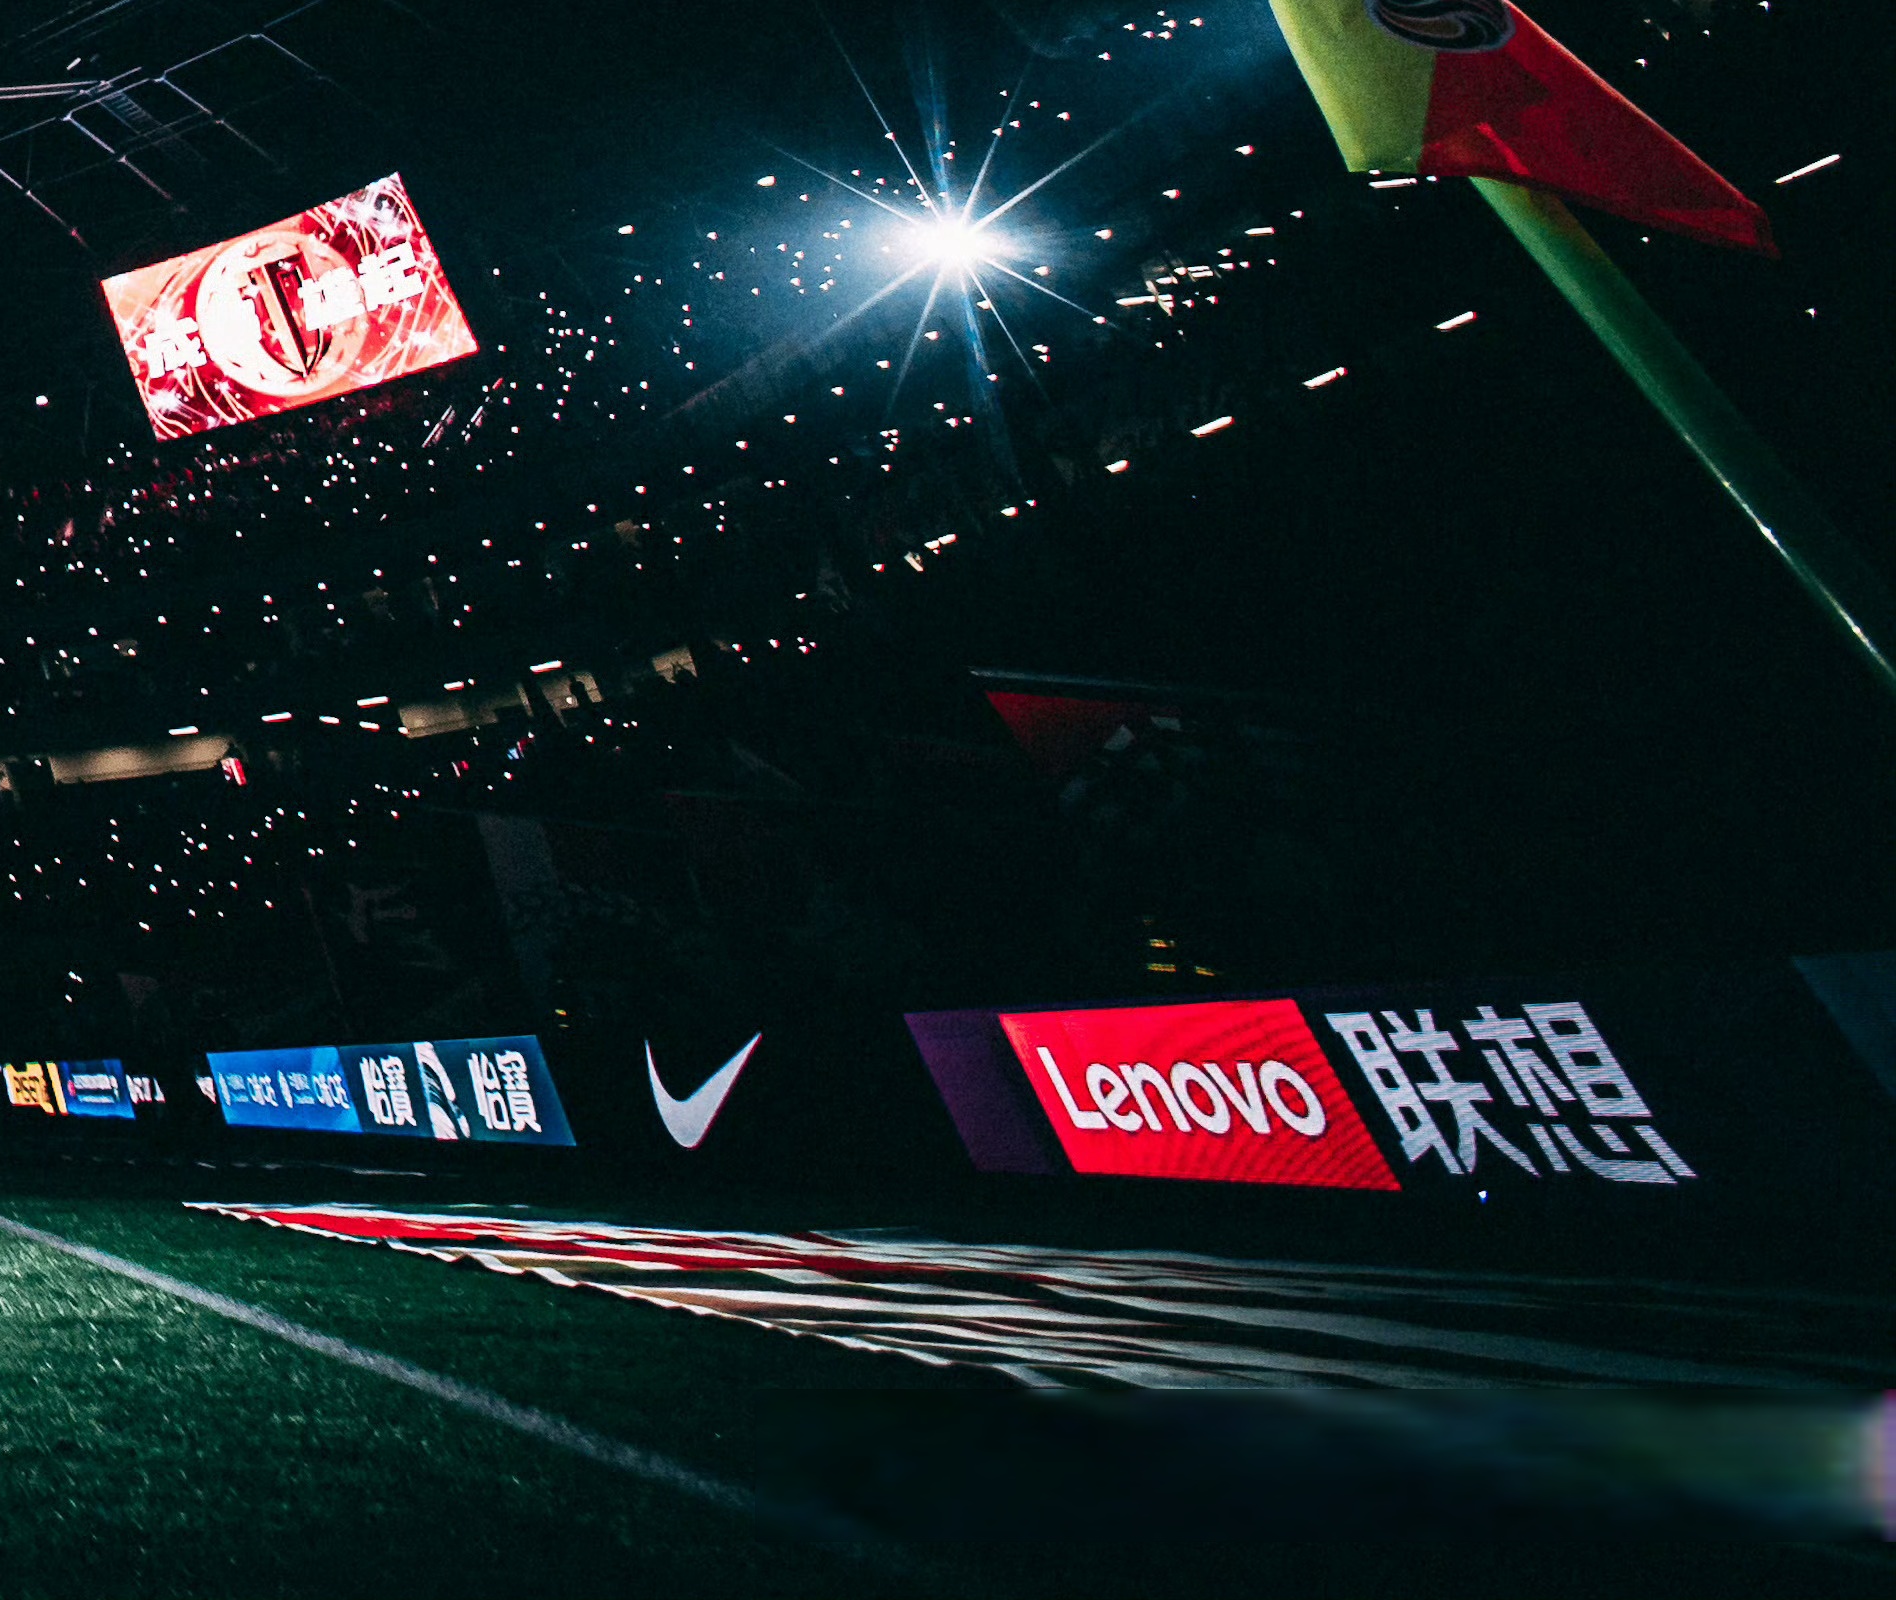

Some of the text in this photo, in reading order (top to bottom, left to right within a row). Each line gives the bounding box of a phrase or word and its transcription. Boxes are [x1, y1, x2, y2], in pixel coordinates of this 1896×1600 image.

[360, 1055, 416, 1127] 怡寶
[467, 1050, 542, 1133] 怡寶
[1037, 1046, 1326, 1136] Lenovo
[1326, 1001, 1697, 1184] 联想
